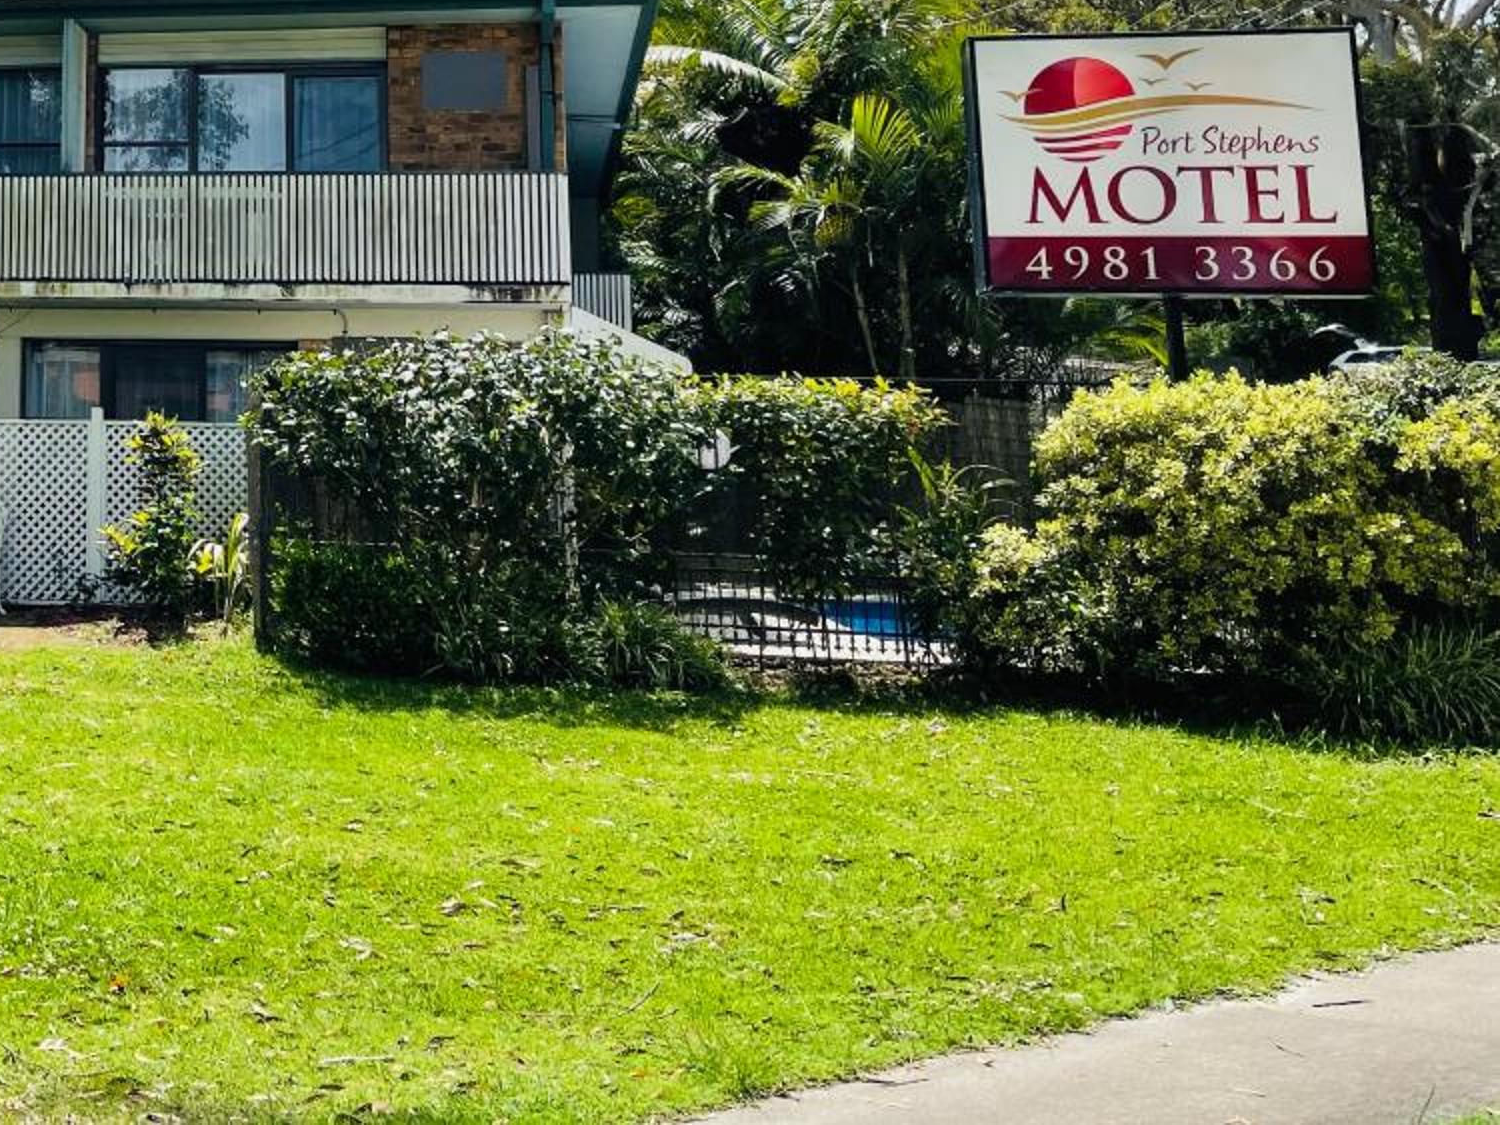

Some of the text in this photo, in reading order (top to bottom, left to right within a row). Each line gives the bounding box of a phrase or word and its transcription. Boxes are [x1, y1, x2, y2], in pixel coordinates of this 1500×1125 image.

[1141, 124, 1321, 160] Port Stephens
[1025, 165, 1339, 225] MOTEL
[1026, 245, 1337, 282] 4981 3366
